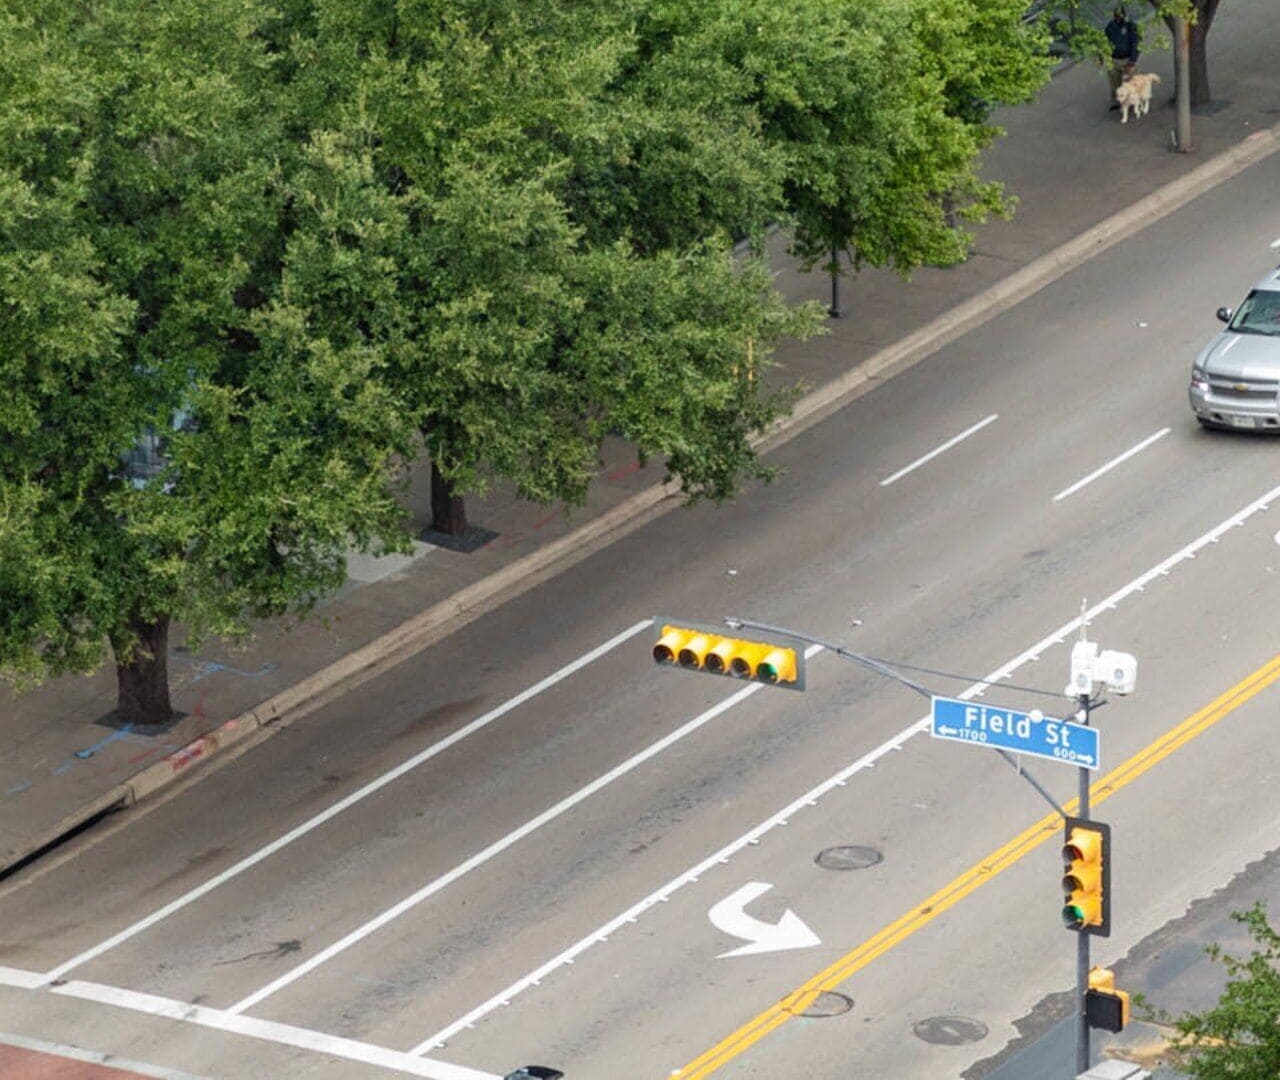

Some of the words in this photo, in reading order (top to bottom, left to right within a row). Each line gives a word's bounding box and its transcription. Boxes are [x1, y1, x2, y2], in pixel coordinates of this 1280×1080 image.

[965, 706, 1031, 739] Field
[1046, 723, 1070, 748] St
[959, 728, 987, 742] 1700
[1053, 747, 1077, 761] 600
